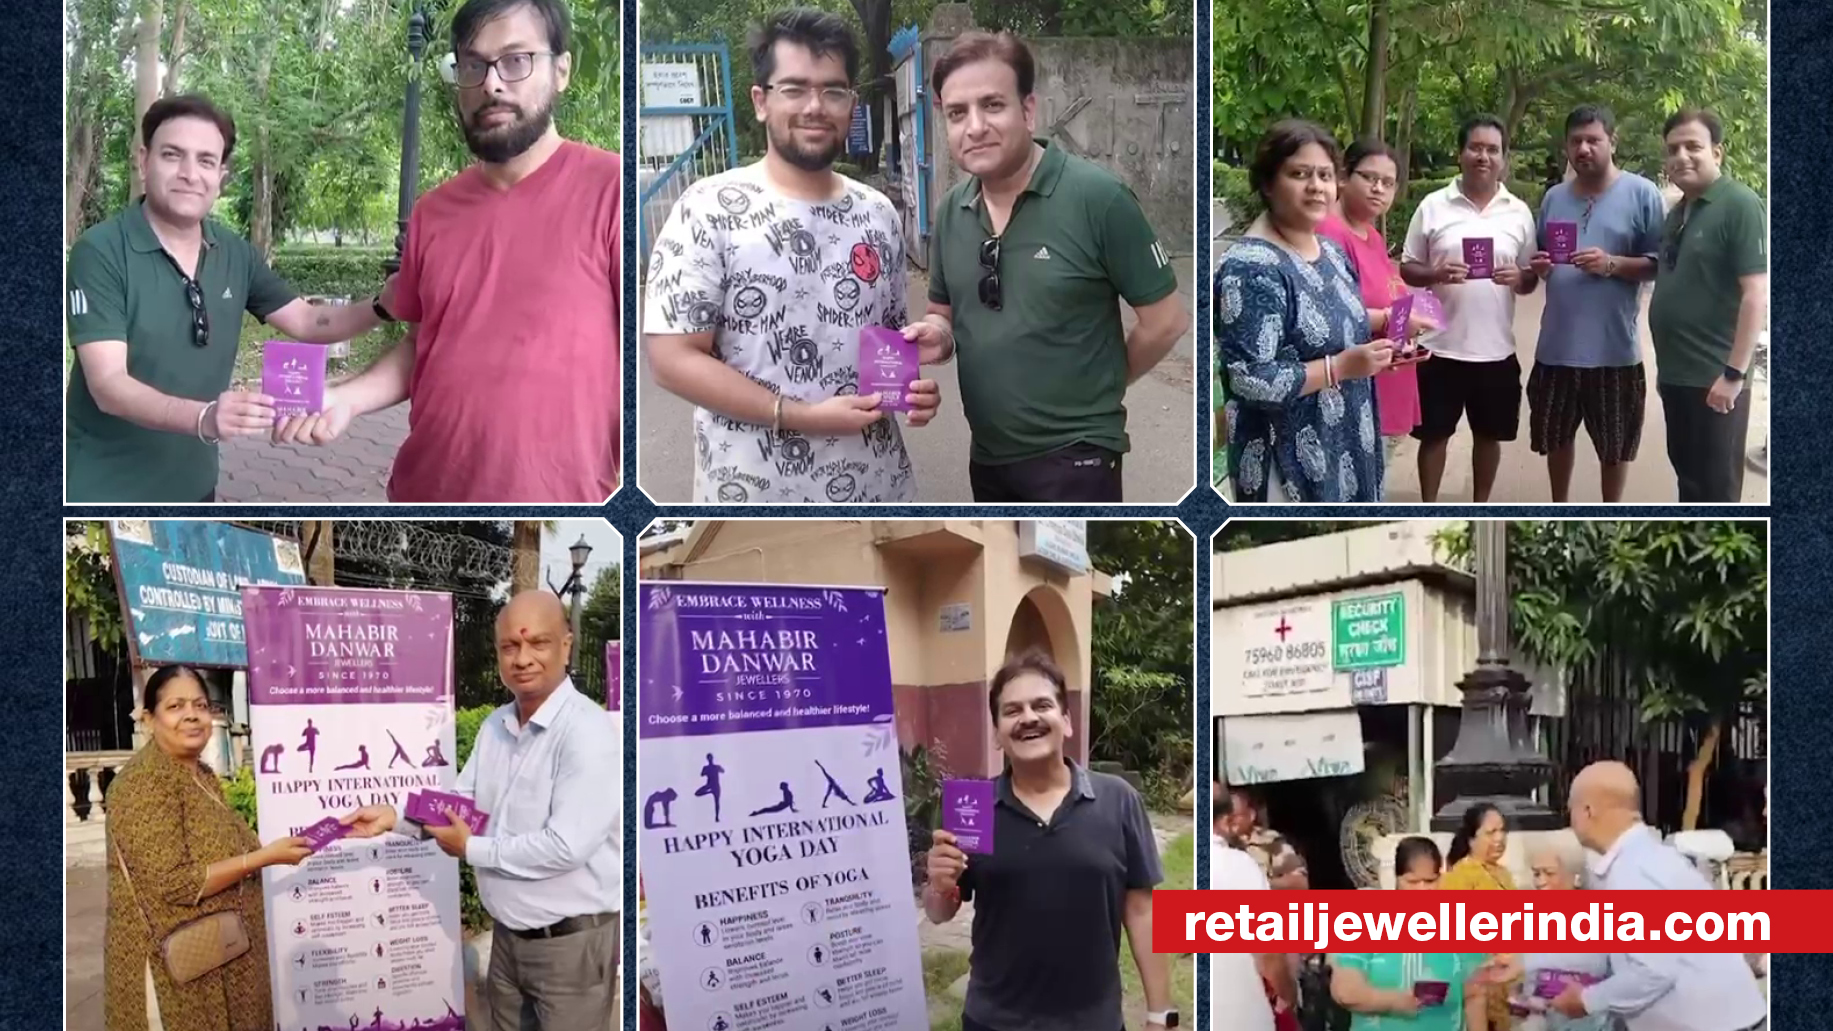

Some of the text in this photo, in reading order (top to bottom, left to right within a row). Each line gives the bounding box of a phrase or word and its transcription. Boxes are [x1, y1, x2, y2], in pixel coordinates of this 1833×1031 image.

[784, 355, 823, 385] VENOM
[775, 451, 815, 478] VENOM
[162, 562, 216, 587] CUSTODIAN
[216, 571, 228, 590] OF
[139, 585, 202, 610] CONTROLLED
[202, 596, 216, 614] BY
[298, 596, 404, 609] EMBRACE WELLNESS
[677, 594, 823, 610] EMBRACE WELLNESS
[1340, 598, 1397, 620] SECURITY
[744, 612, 765, 621] with
[1348, 617, 1388, 637] CHECK
[305, 623, 399, 641] MAHABIR
[691, 630, 819, 651] MAHABIR
[311, 641, 395, 658] DANWAR
[701, 653, 817, 674] DANWAR
[318, 671, 390, 680] SINCE 1970
[735, 673, 791, 686] JEWELLERS
[269, 686, 298, 695] Choose
[305, 686, 325, 695] more
[326, 685, 359, 695] balanced
[360, 686, 373, 694] and
[373, 685, 404, 695] healthier
[716, 689, 812, 702] SINCE 1970
[648, 704, 870, 725] Choose a more balanced and healthier lifestyle!
[271, 773, 442, 795] HAPPY INTERNATIONAL
[318, 791, 402, 810] YOGA DAY
[664, 811, 889, 855] HAPPY INTERNATIONAL
[730, 836, 841, 868] YOGA DAY
[694, 866, 870, 910] BENEFITS OF YOGA
[720, 909, 769, 926] HAPPINESS
[829, 926, 863, 941] POSTURE
[726, 951, 767, 968] BALANCE
[836, 966, 887, 987] BETTER SLEEP
[733, 991, 789, 1013] SELF ESTEEM
[840, 1006, 888, 1027] WEIGHT LOSS
